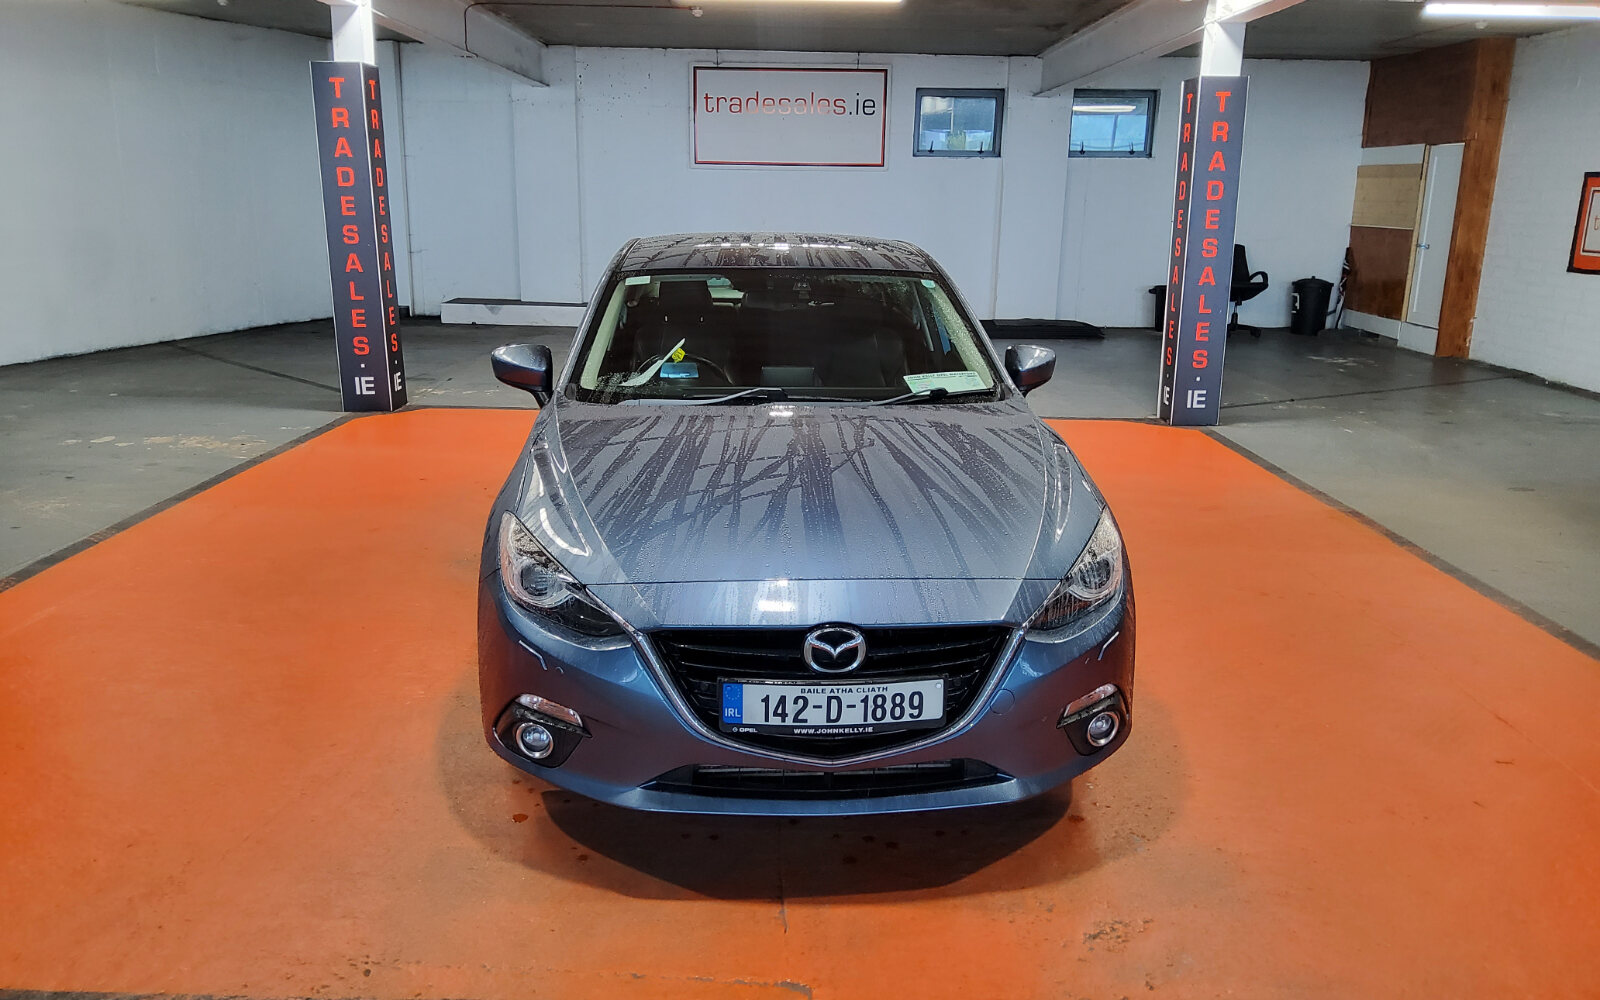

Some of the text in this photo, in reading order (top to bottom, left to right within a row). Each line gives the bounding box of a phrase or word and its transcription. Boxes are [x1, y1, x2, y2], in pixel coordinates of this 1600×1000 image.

[703, 91, 876, 116] tradesales.ie
[800, 687, 827, 695] BAILE
[856, 686, 889, 694] CLIATH
[724, 707, 742, 718] IRL
[760, 690, 924, 724] 142-D-1889
[793, 726, 874, 735] WWW.JOHNKELLY.IE
